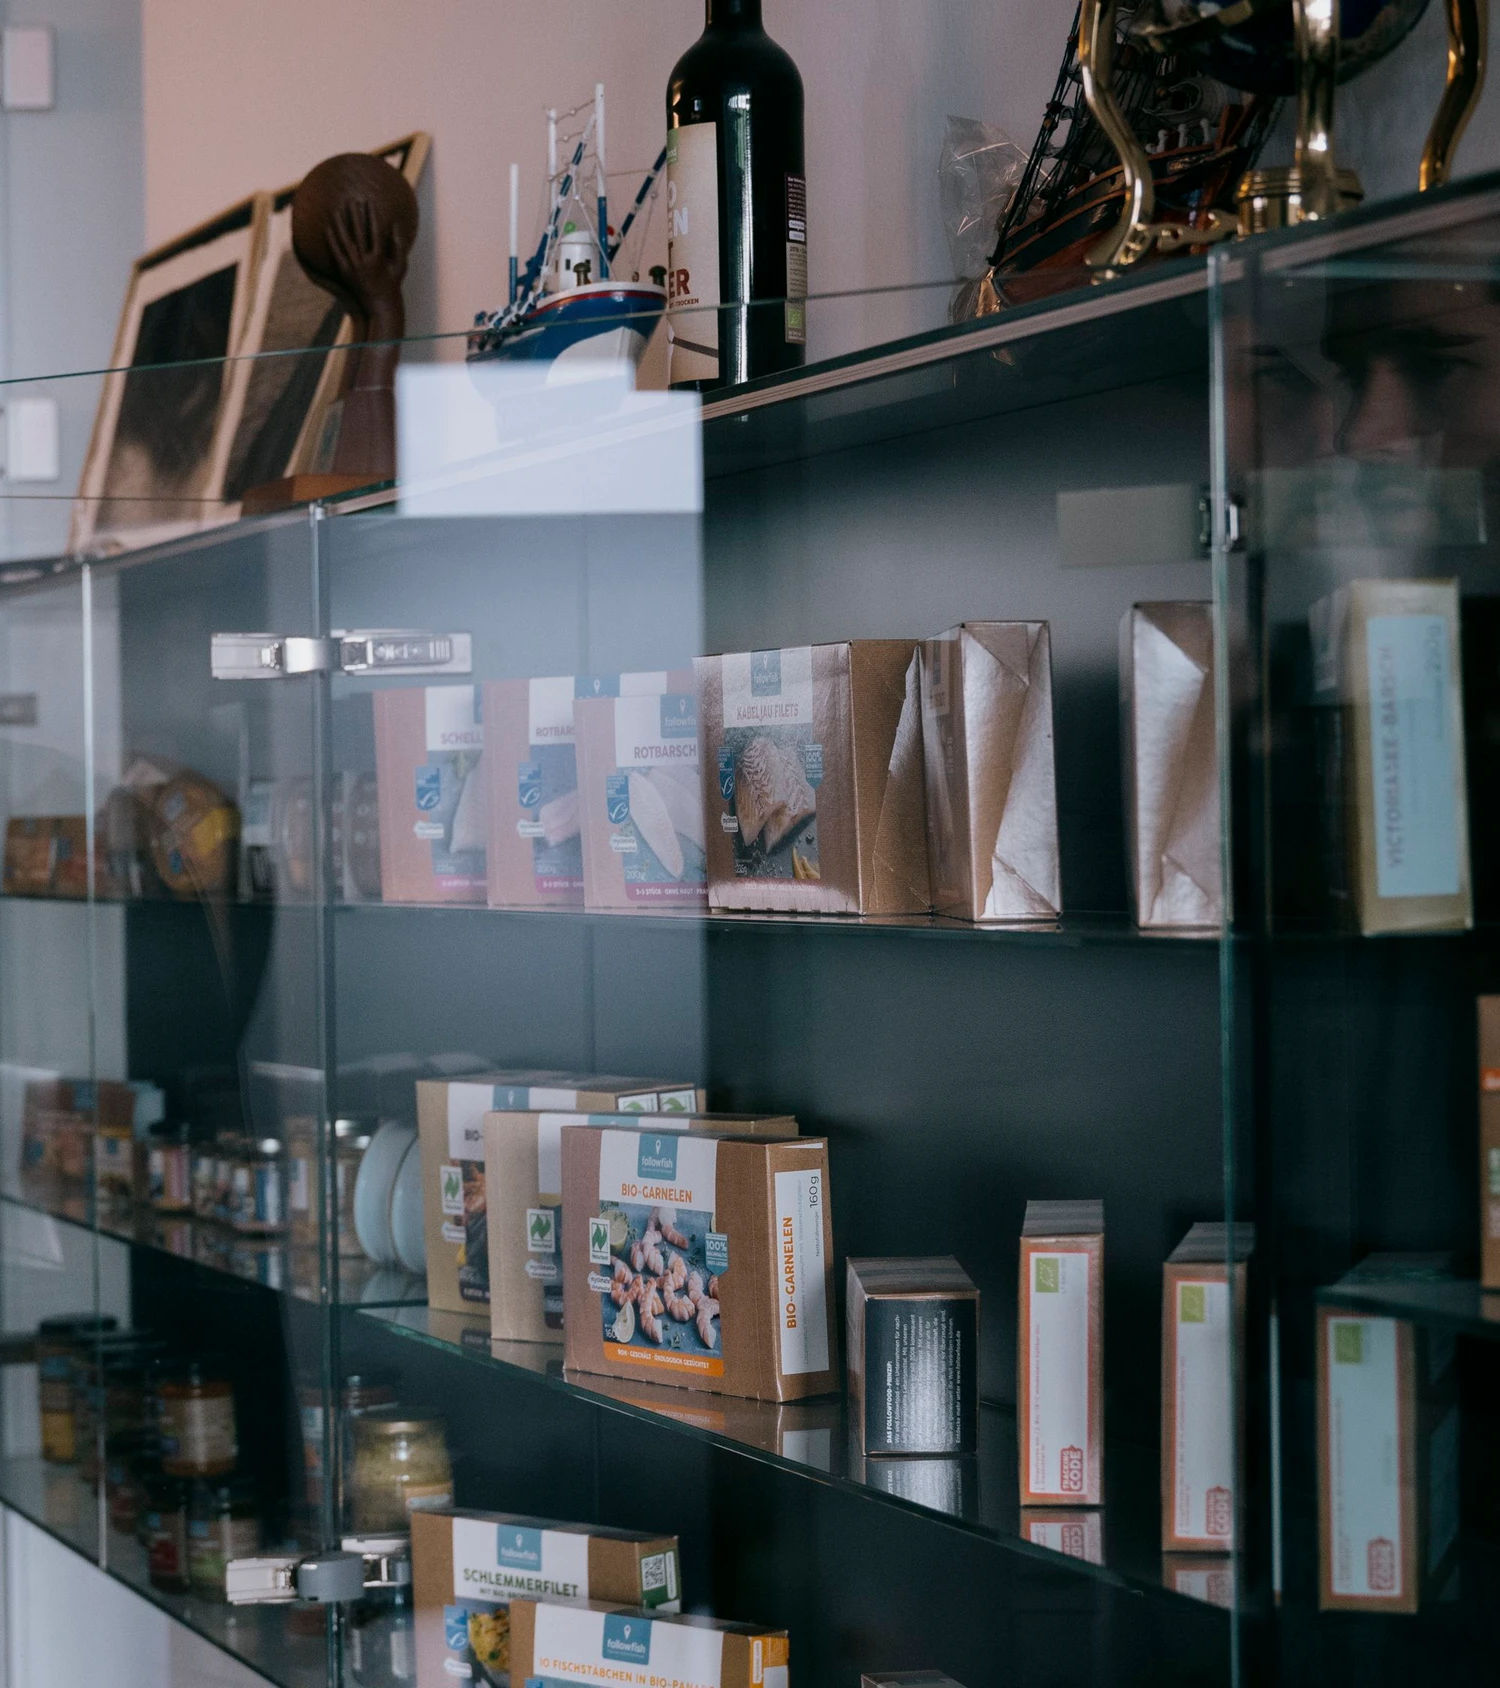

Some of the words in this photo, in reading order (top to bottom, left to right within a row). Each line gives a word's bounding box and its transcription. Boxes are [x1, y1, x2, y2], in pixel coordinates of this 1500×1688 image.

[737, 704, 773, 721] KABELJAU
[774, 703, 799, 718] FILETS
[634, 744, 697, 759] ROTBARSCH
[641, 1155, 673, 1169] followfish
[621, 1183, 693, 1204] BIO-GARNELEN
[808, 1185, 819, 1209] 160
[706, 1240, 727, 1251] 100%
[783, 1216, 797, 1329] BIO-GARNELEN
[630, 1350, 651, 1360] GESCHÄLT
[654, 1353, 683, 1365] ÖKOLOGISCH
[683, 1358, 709, 1369] GEZÜCHTET
[1070, 1451, 1081, 1490] CODE
[463, 1567, 579, 1597] SCHLEMMERFILET
[607, 1638, 646, 1653] followfish
[539, 1657, 550, 1668] 10
[553, 1660, 632, 1683] FISCHSTÄBCHEN
[636, 1673, 646, 1684] IN
